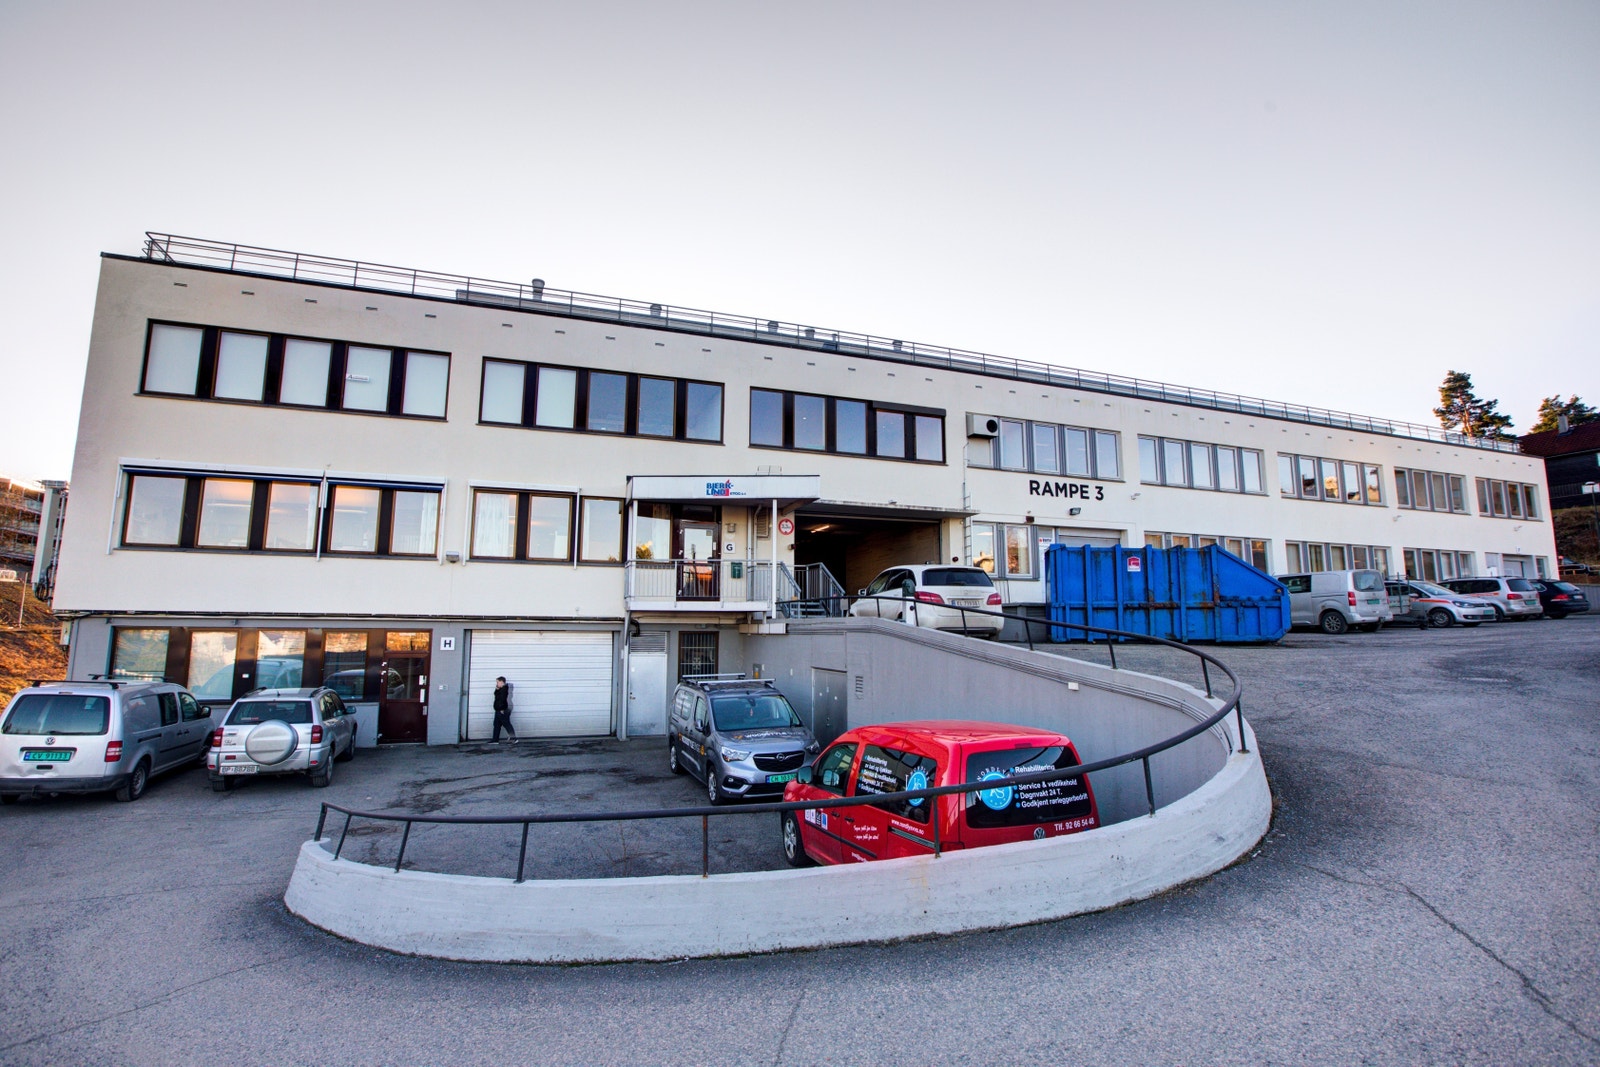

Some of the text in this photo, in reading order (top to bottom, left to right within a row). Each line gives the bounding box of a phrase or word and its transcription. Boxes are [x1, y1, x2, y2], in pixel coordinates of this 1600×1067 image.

[1029, 480, 1104, 501] RAMPE 3
[726, 543, 733, 551] G
[443, 639, 452, 648] H
[1014, 764, 1056, 773] Rehabilitering
[1018, 782, 1041, 791] Service
[1047, 779, 1078, 788] vedlikehold
[1020, 790, 1049, 799] Døgnvakt
[1021, 799, 1049, 808] Godkjent
[1054, 823, 1065, 831] Tlf.
[1065, 821, 1073, 830] 92
[1073, 820, 1081, 828] 66
[1081, 819, 1088, 827] 54
